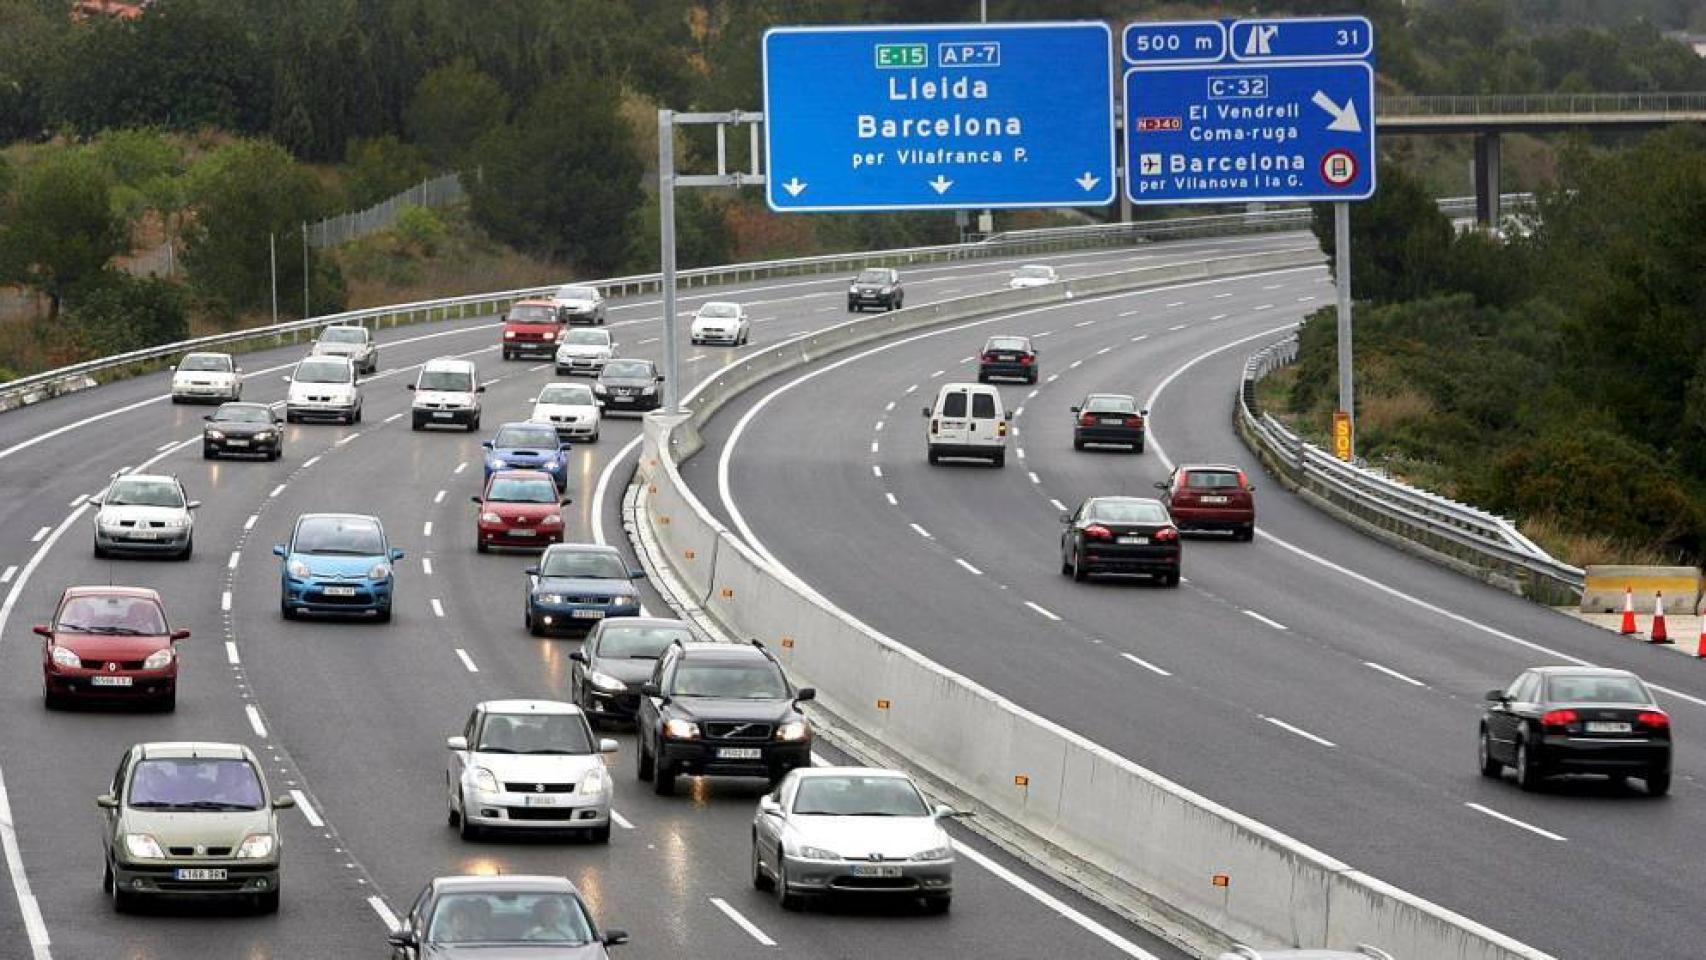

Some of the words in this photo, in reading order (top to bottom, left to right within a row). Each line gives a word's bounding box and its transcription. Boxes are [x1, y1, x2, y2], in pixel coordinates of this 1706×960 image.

[1137, 36, 1180, 51] 500
[1195, 37, 1212, 49] m
[1336, 30, 1358, 46] 31
[879, 48, 924, 65] E-15
[889, 76, 988, 101] Lleida
[1212, 80, 1265, 95] C-32
[1189, 105, 1207, 120] El
[1217, 102, 1299, 119] Vendrell
[858, 114, 1022, 139] Barcelona
[1189, 126, 1299, 143] Coma-ruga
[853, 152, 885, 169] per
[896, 148, 1003, 165] Vilafranca
[1014, 146, 1029, 163] P.
[1169, 152, 1306, 174] Barcelona
[1140, 179, 1166, 193] per
[1174, 175, 1248, 190] Vilanova
[1265, 174, 1282, 187] la
[1287, 173, 1304, 187] G.
